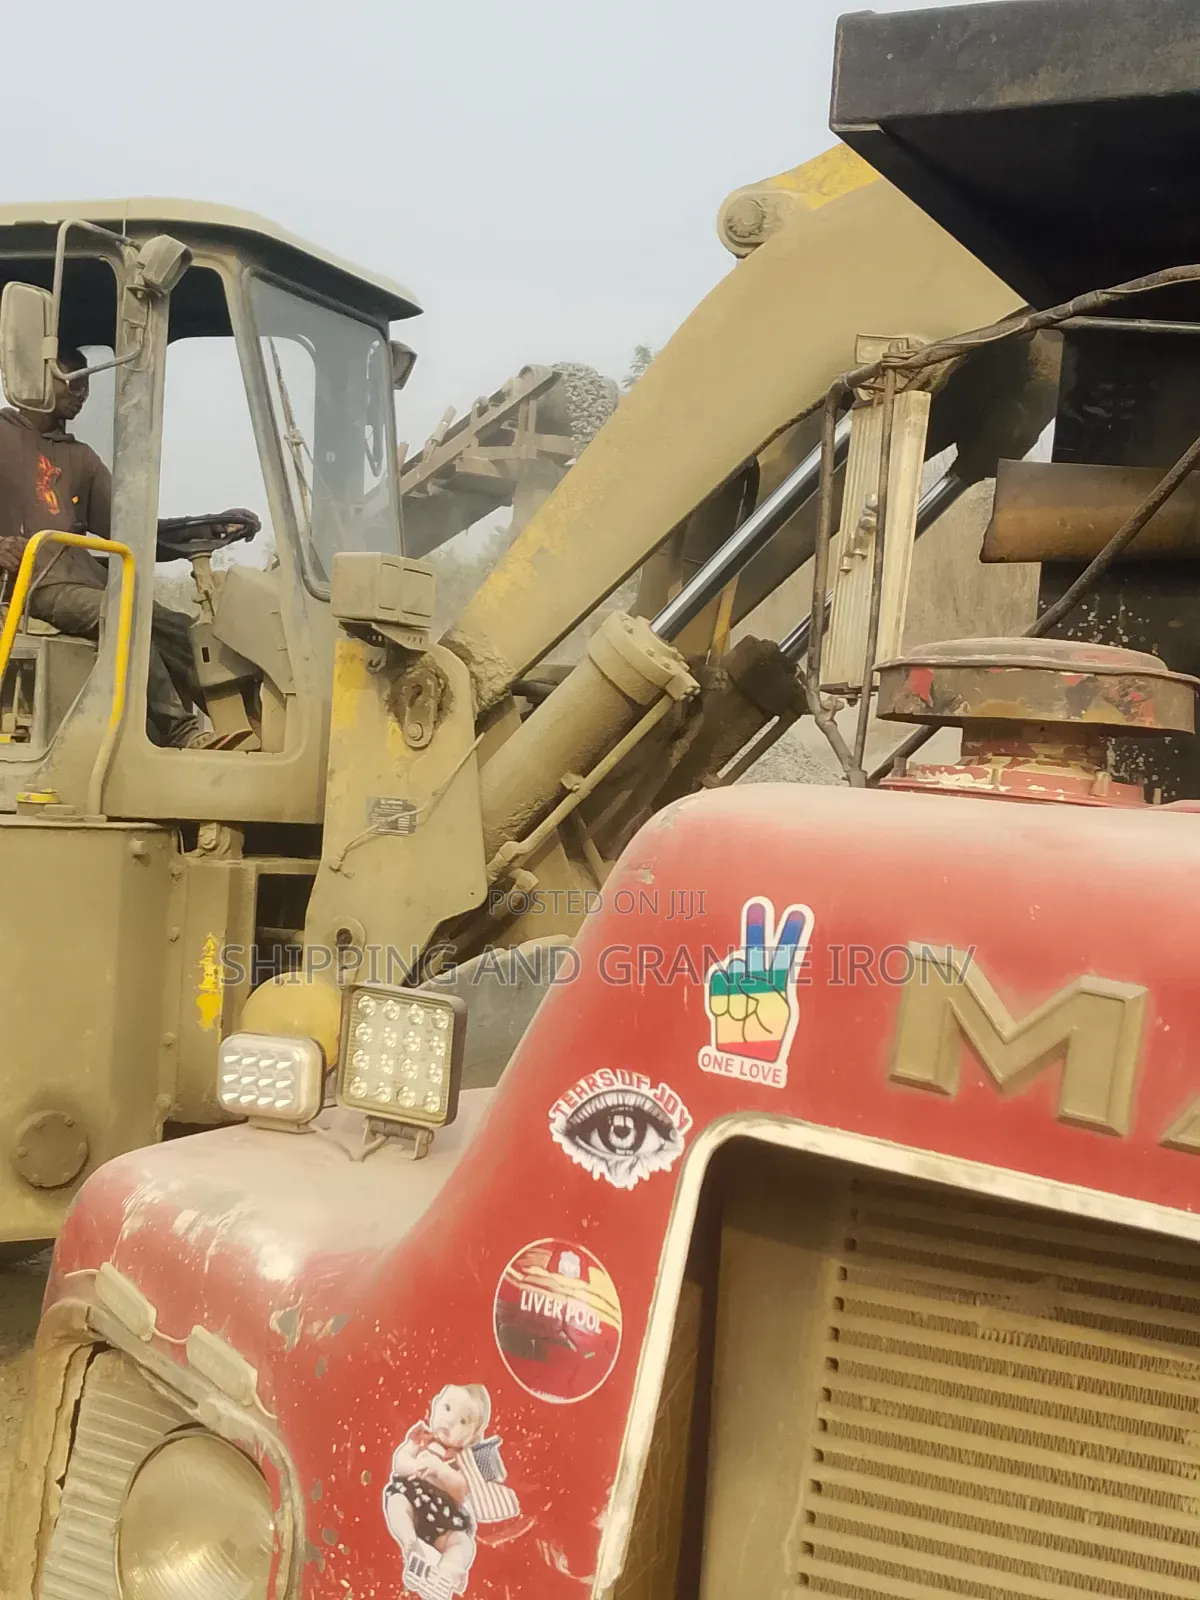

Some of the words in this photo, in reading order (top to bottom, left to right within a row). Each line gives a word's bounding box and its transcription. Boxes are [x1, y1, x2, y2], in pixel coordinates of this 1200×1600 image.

[701, 1053, 734, 1073] ONE
[739, 1060, 782, 1084] LOVE
[889, 941, 1200, 1156] M
[551, 1070, 616, 1118] TEARS
[653, 1085, 691, 1131] JOY
